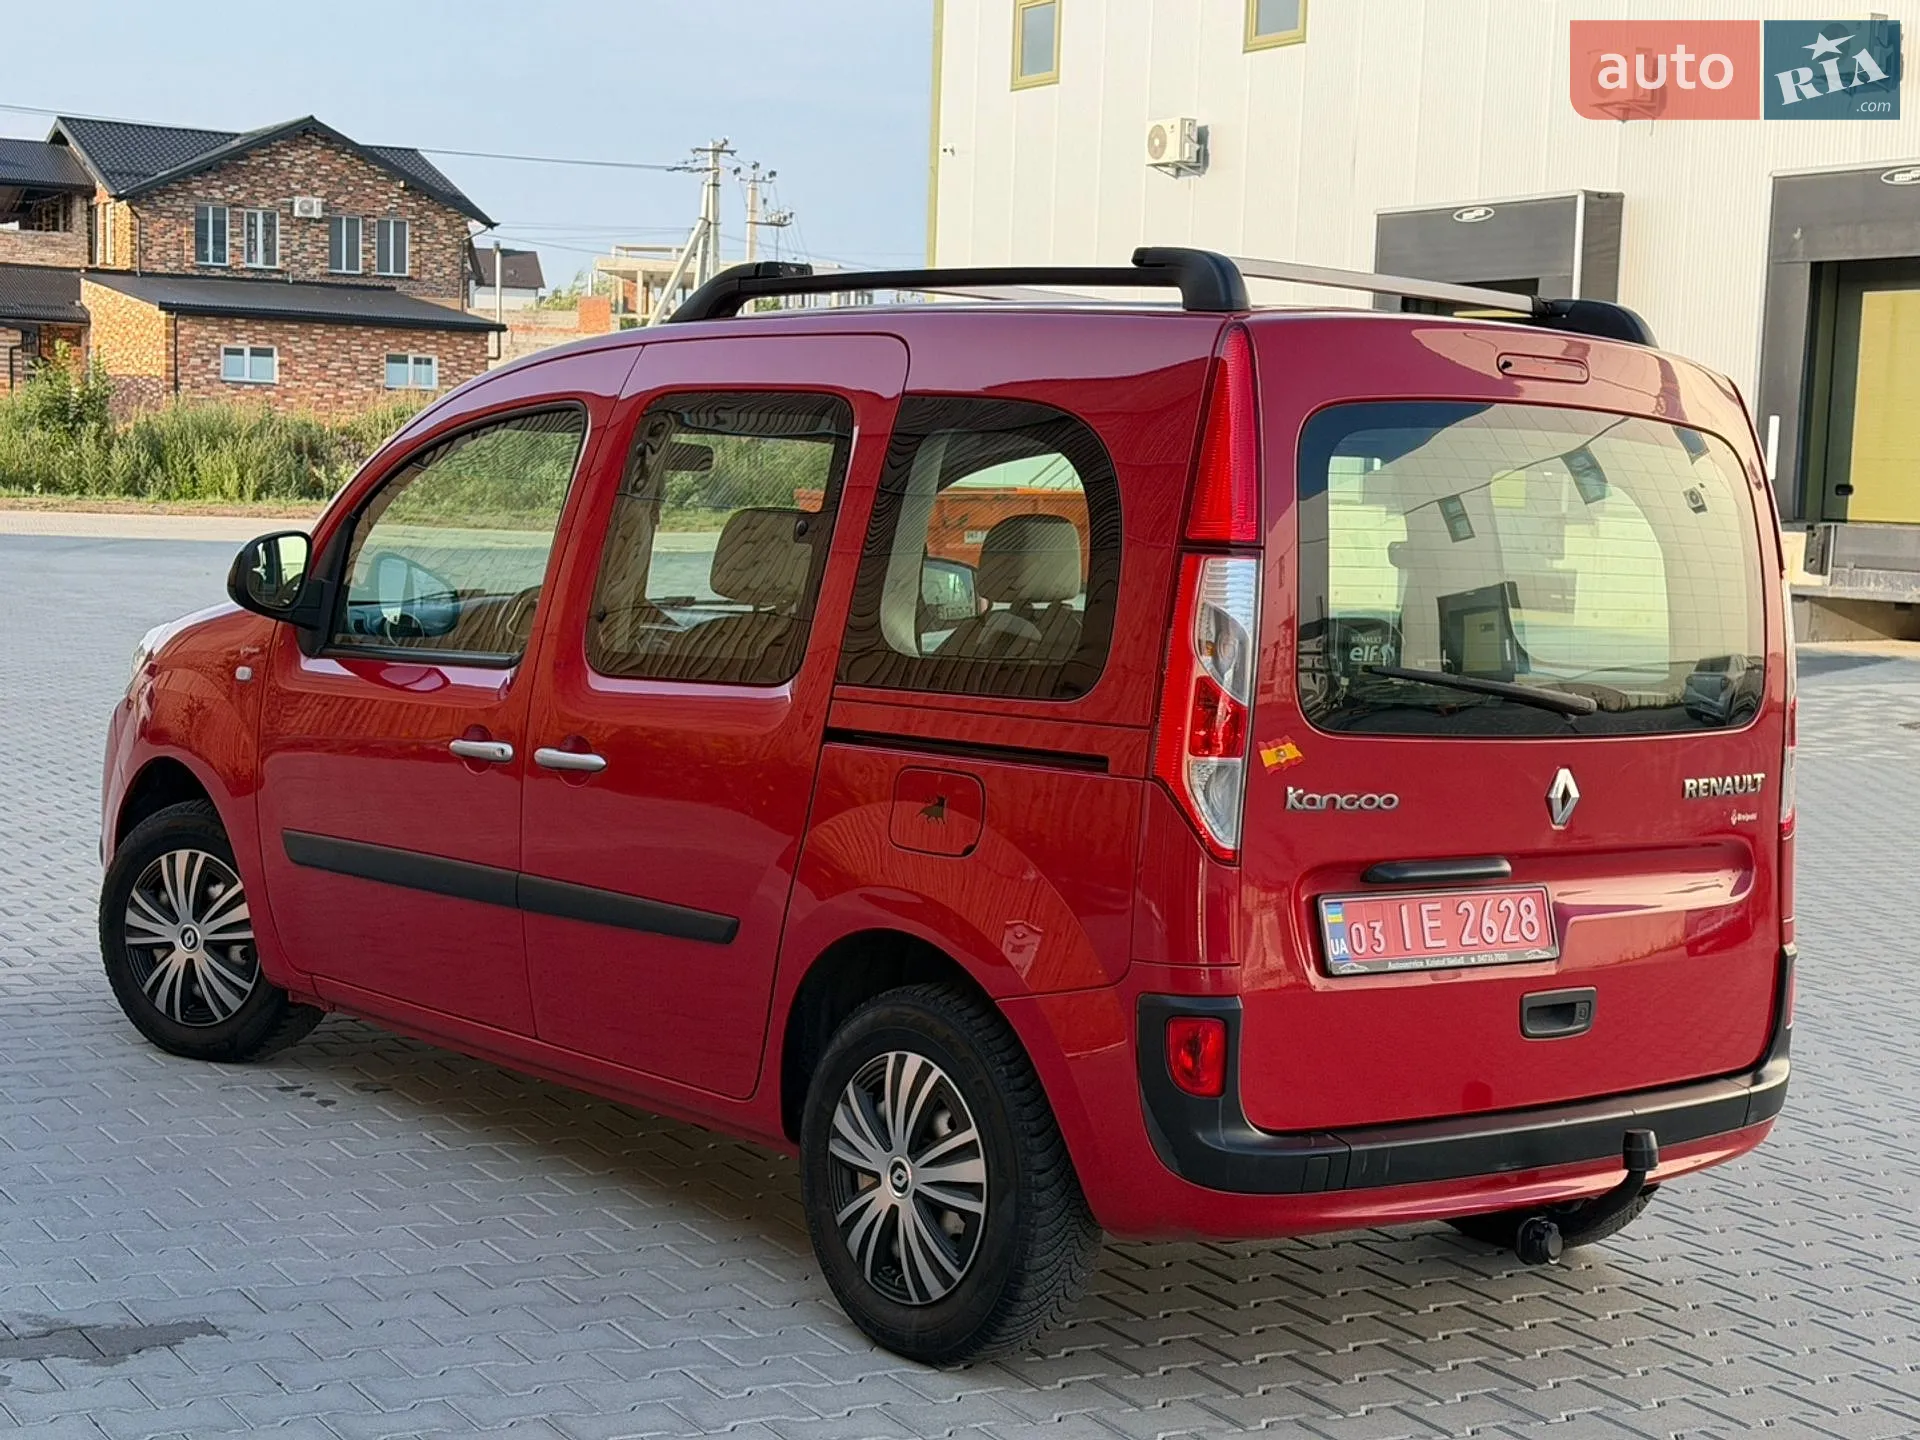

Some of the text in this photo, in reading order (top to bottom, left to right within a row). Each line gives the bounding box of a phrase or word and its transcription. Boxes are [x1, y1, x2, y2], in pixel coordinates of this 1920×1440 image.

[1349, 645, 1379, 662] elf
[1285, 786, 1400, 811] Kangoo
[1683, 773, 1766, 800] RENAULT
[1350, 897, 1540, 954] 03 IE 2628
[1330, 938, 1349, 956] UA
